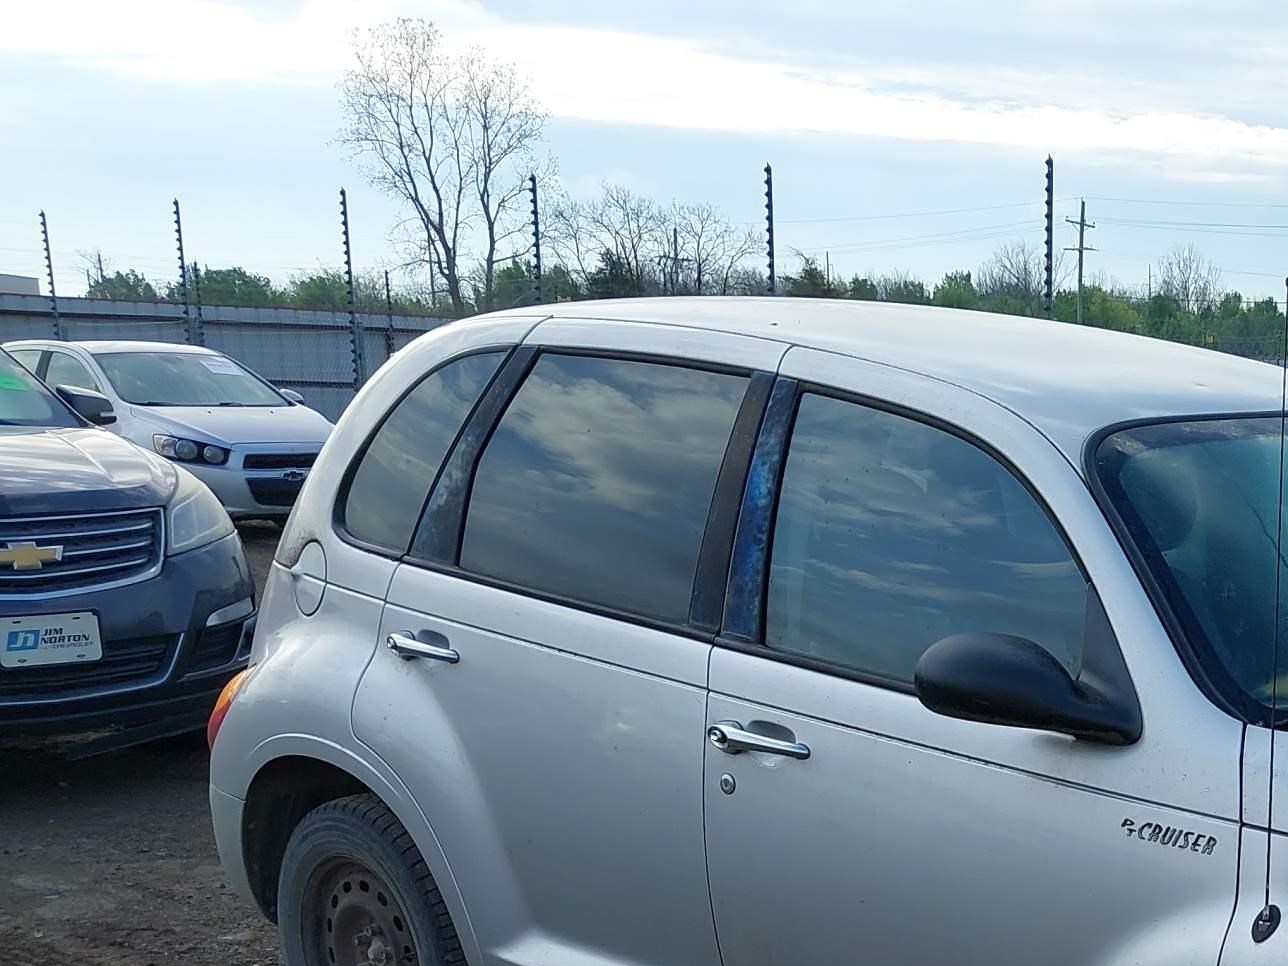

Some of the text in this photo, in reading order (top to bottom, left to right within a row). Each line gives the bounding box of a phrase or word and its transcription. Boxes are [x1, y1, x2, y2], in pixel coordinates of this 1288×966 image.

[42, 627, 64, 637] JIM
[40, 633, 90, 645] NORTON
[1137, 822, 1218, 856] CRUISER
